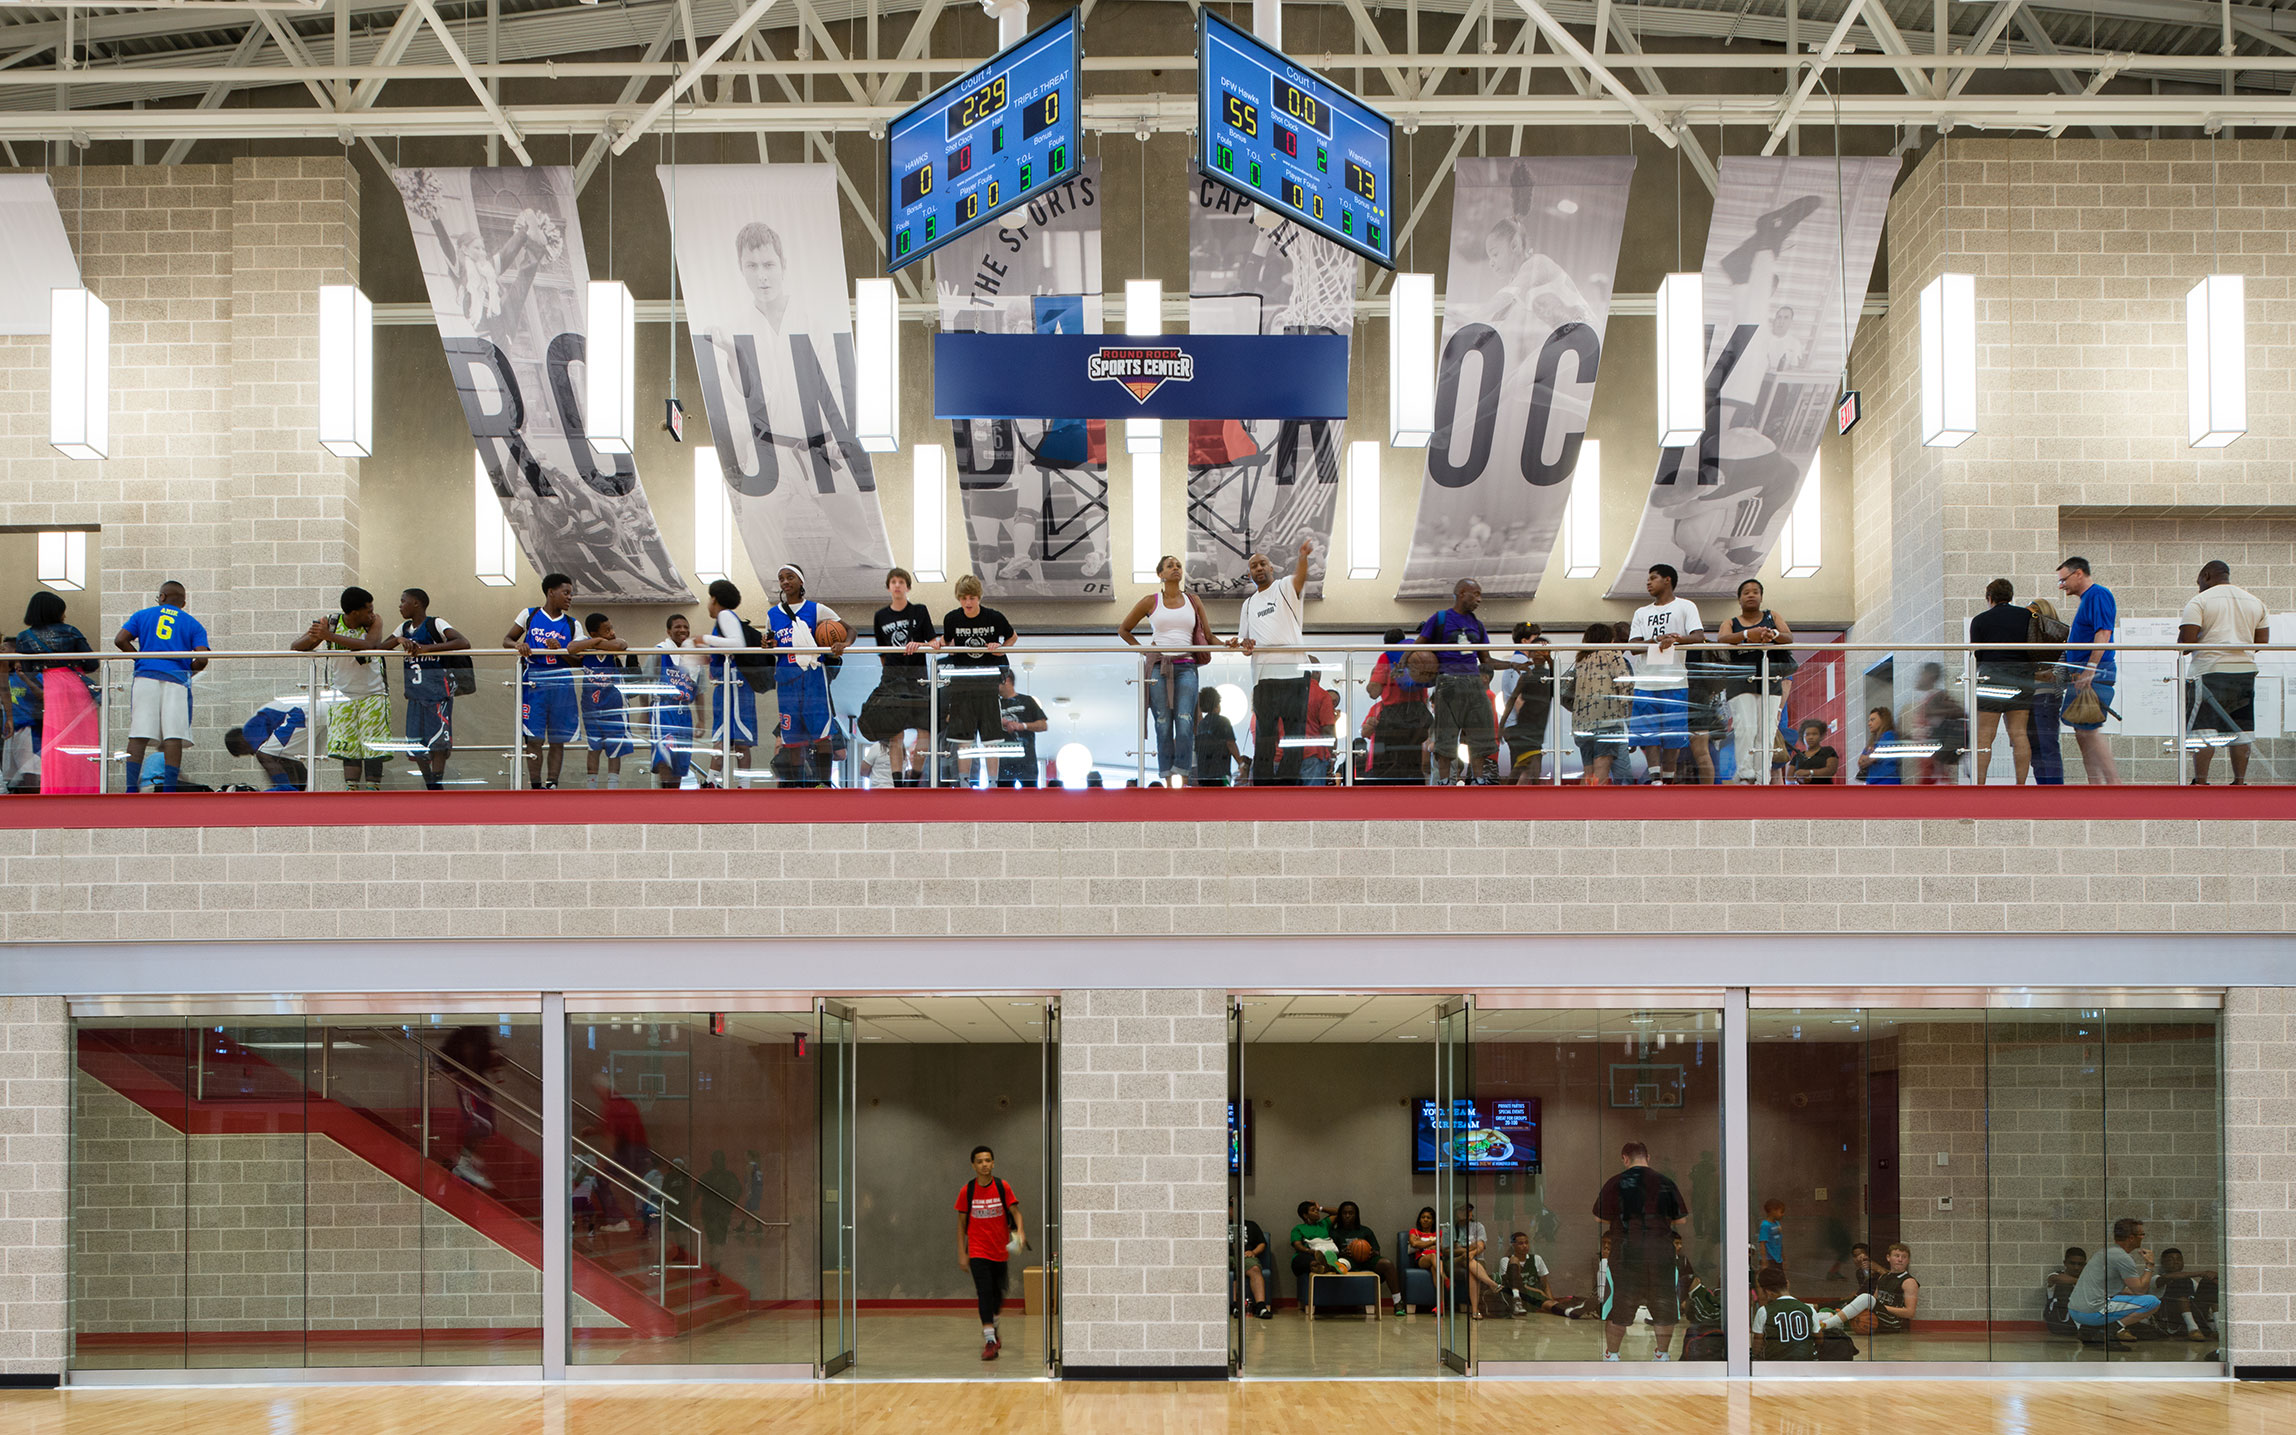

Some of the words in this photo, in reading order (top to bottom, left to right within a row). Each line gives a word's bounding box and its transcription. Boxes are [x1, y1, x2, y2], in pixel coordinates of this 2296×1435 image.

[960, 70, 985, 92] Court
[986, 66, 992, 77] 4
[1286, 66, 1310, 89] Court
[1013, 88, 1039, 109] TRIPLE
[1040, 70, 1069, 94] THREAT
[1221, 76, 1237, 93] DFW
[1238, 86, 1260, 105] Hawks
[963, 78, 1006, 127] 2:29
[1045, 92, 1058, 125] 0
[1288, 86, 1316, 126] 0.0
[992, 115, 1004, 127] Half
[1230, 97, 1257, 136] 55
[1270, 110, 1285, 126] Shot
[1283, 118, 1299, 133] Clock
[945, 141, 958, 154] Shot
[957, 133, 973, 147] Clock
[999, 127, 1004, 148] 1
[1033, 131, 1052, 146] Bonus
[1049, 134, 1065, 149] Fouls
[1217, 132, 1233, 148] Fouls
[1229, 128, 1247, 145] Bonus
[1286, 130, 1296, 157] 0
[1316, 136, 1328, 149] Half
[905, 152, 929, 172] HAWKS
[960, 145, 971, 171] 0
[1016, 153, 1033, 166] T.O.L.
[1054, 145, 1065, 173] 0
[1217, 145, 1233, 173] 10
[1246, 147, 1263, 164] T.O.L.
[1317, 146, 1327, 173] 2
[1348, 148, 1372, 168] Warriors
[920, 164, 932, 195] 0
[960, 182, 977, 197] Player
[978, 174, 993, 187] Fouls
[1021, 163, 1031, 191] 3
[1250, 161, 1261, 188] 0
[1285, 168, 1302, 183] Player
[1302, 177, 1318, 192] Fouls
[1352, 164, 1375, 201] 73
[988, 180, 999, 208] 0
[1293, 184, 1303, 210] 0
[1338, 197, 1354, 212] T.O.L.
[1354, 195, 1370, 210] Bonus
[906, 202, 923, 216] Bonus
[922, 205, 938, 218] T.O.L.
[967, 193, 978, 219] 0
[1313, 194, 1323, 219] 0
[895, 219, 910, 232] Fouls
[926, 214, 936, 241] 3
[1343, 210, 1352, 235] 3
[1366, 212, 1380, 225] Fouls
[900, 229, 910, 255] 0
[970, 253, 1008, 308] THE
[1200, 179, 1300, 257] CAPAL
[1371, 226, 1381, 249] 4
[1103, 350, 1143, 359] ROUND
[1145, 350, 1179, 359] ROCK
[1091, 358, 1141, 377] SPORTS
[1143, 358, 1190, 377] CENTER
[1840, 399, 1853, 429] EXIT
[1083, 582, 1110, 594] OF
[1192, 574, 1250, 593] TEXAS
[1257, 606, 1275, 618] PUMA
[1648, 611, 1672, 626] FAST
[156, 614, 175, 640] 6
[1652, 626, 1665, 639] AS
[410, 663, 423, 685] 3
[591, 689, 601, 703] 4
[335, 740, 349, 752] 22
[443, 730, 450, 741] 3
[1453, 1121, 1480, 1129] TEAM
[1774, 1310, 1809, 1343] 10
